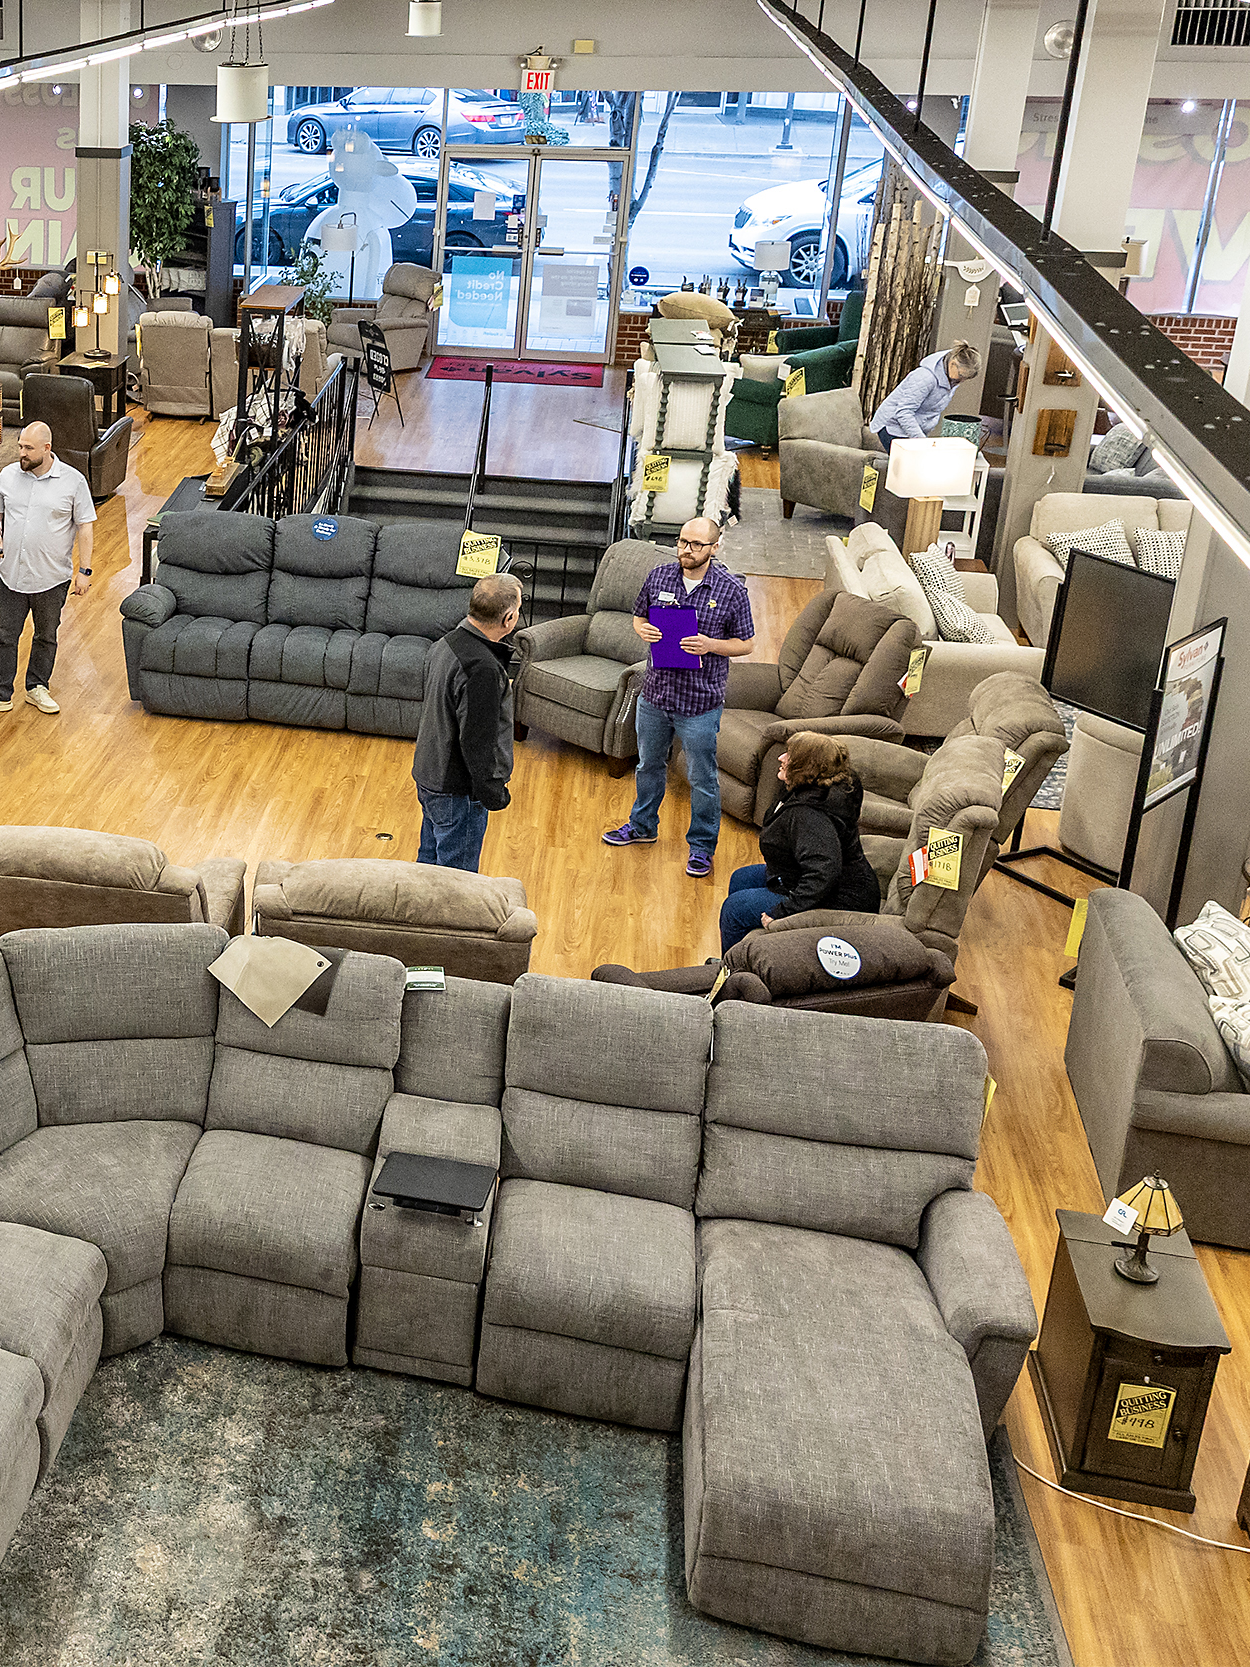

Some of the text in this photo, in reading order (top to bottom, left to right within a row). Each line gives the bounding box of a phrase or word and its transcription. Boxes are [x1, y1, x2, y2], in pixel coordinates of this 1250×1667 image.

[526, 72, 550, 90] EXIT
[1177, 643, 1203, 669] Sylvan
[1154, 720, 1203, 759] UNLIMITED!
[930, 836, 958, 849] QUITTING
[929, 844, 958, 859] BUSINESS
[819, 946, 843, 957] POWER
[829, 958, 837, 966] Try
[1120, 1391, 1167, 1408] QUITTING
[1119, 1400, 1167, 1416] BUSINESS
